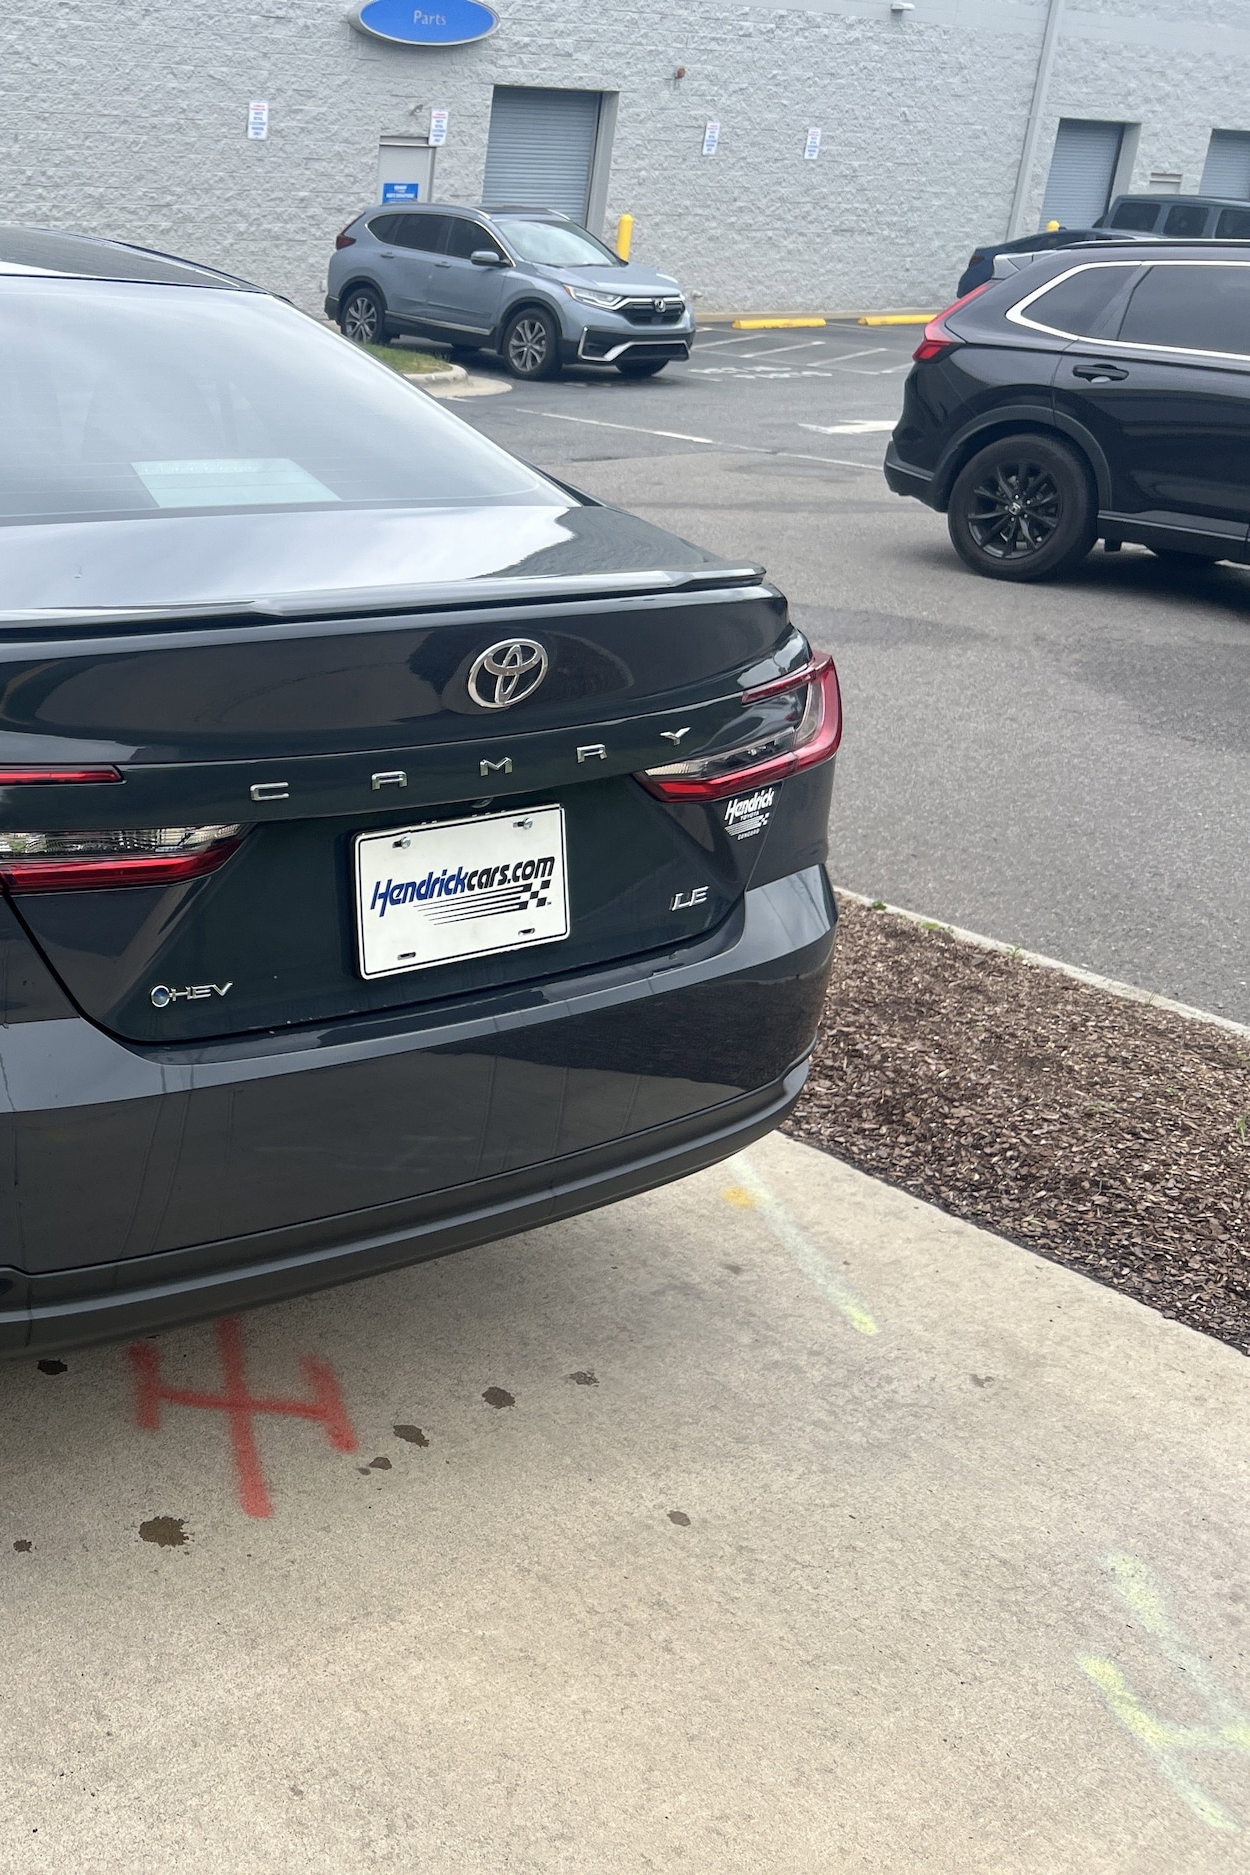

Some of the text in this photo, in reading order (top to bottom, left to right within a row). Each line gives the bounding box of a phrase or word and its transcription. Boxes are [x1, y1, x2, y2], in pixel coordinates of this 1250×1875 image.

[413, 10, 447, 26] Parts
[250, 727, 691, 801] CAMRY
[724, 787, 775, 825] Hendrick
[740, 810, 759, 821] TOYOTA
[370, 856, 555, 918] Hendrickcars.com
[671, 886, 709, 911] LE
